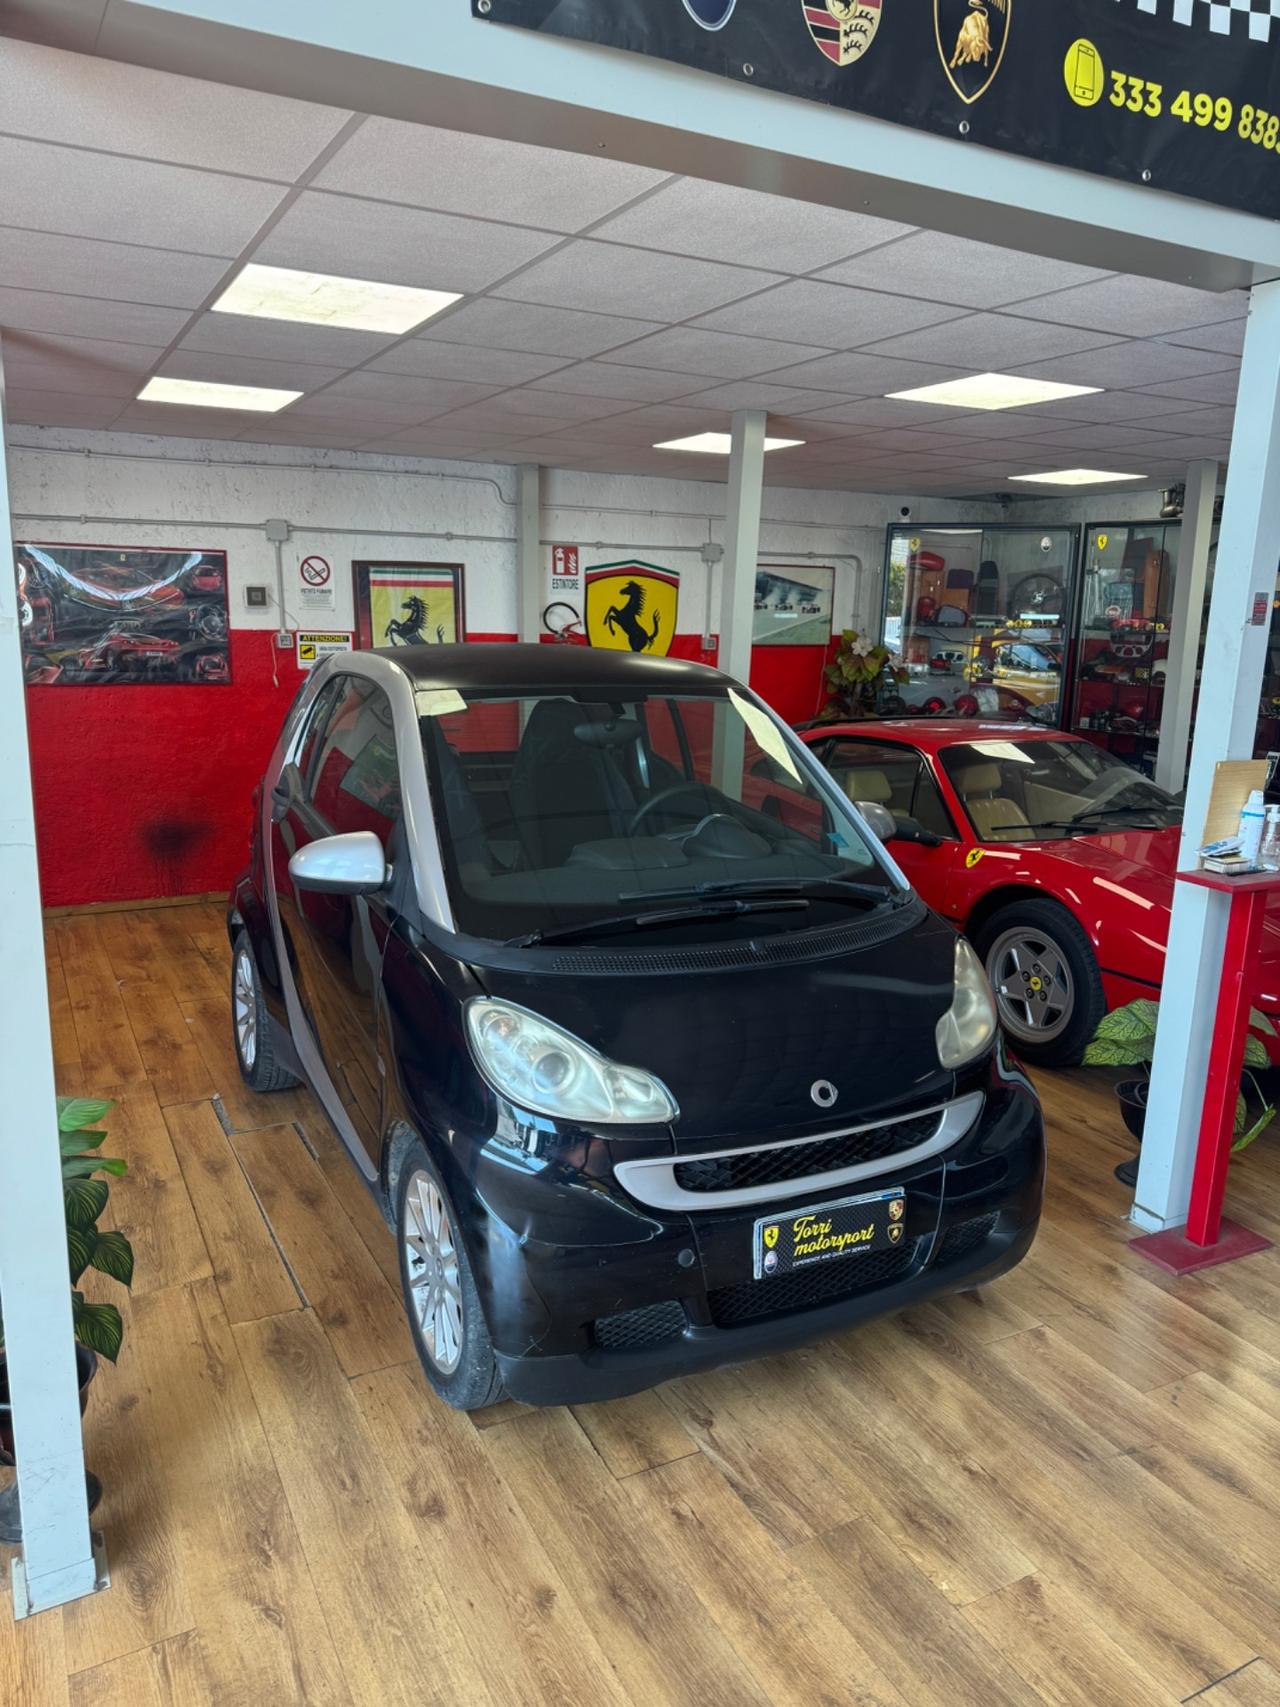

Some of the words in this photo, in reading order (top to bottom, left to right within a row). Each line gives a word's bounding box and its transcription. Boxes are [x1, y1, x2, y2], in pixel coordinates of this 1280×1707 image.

[1109, 70, 1163, 117] 333
[1170, 91, 1233, 132] 499
[552, 578, 579, 590] ESTINTORE
[793, 1215, 832, 1242] Torri
[793, 1223, 875, 1257] motorsport
